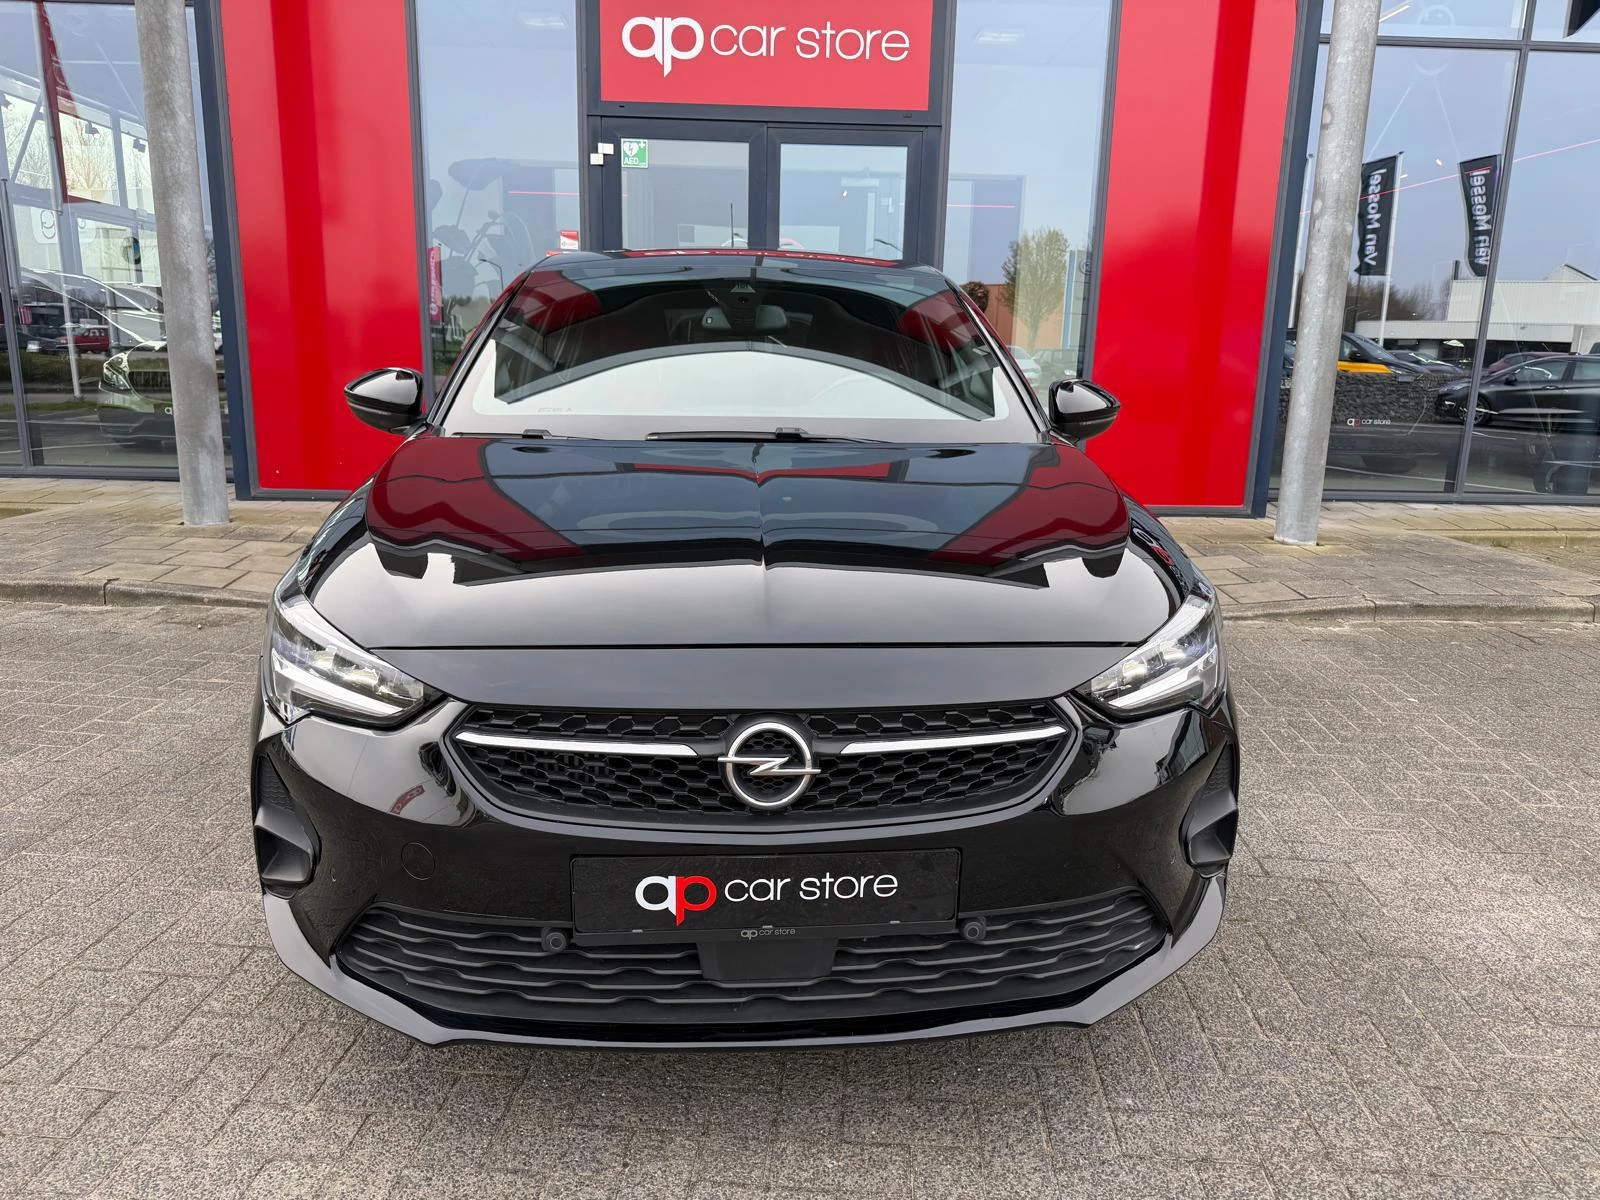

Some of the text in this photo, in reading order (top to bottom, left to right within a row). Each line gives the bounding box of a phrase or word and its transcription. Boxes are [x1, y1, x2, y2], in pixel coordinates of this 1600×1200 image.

[710, 24, 786, 57] car
[795, 21, 910, 62] store
[624, 157, 639, 165] AED
[724, 878, 791, 902] car
[799, 872, 898, 900] store
[774, 928, 796, 936] store
